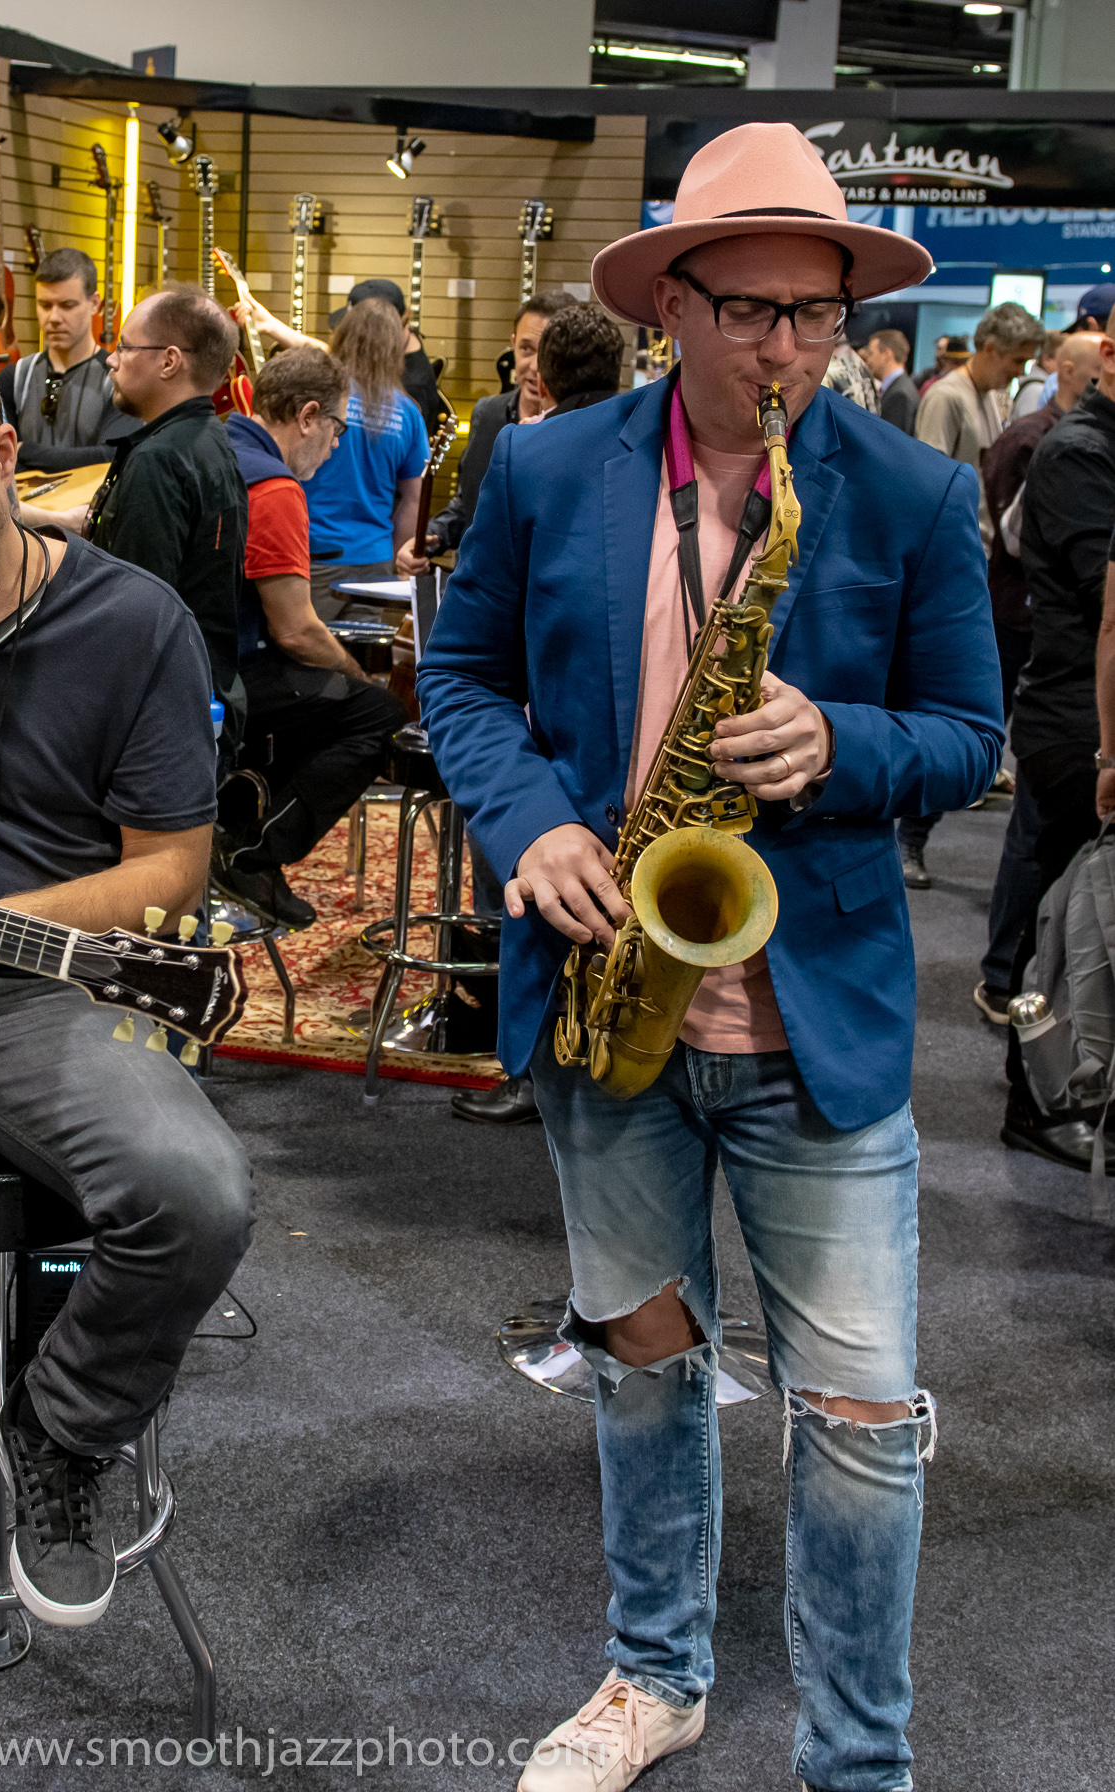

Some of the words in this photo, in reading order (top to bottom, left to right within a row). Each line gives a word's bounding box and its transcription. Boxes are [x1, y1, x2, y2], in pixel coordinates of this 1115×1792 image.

[879, 187, 891, 201] &
[894, 188, 986, 202] MANDOLINS
[41, 1260, 84, 1273] Henrik
